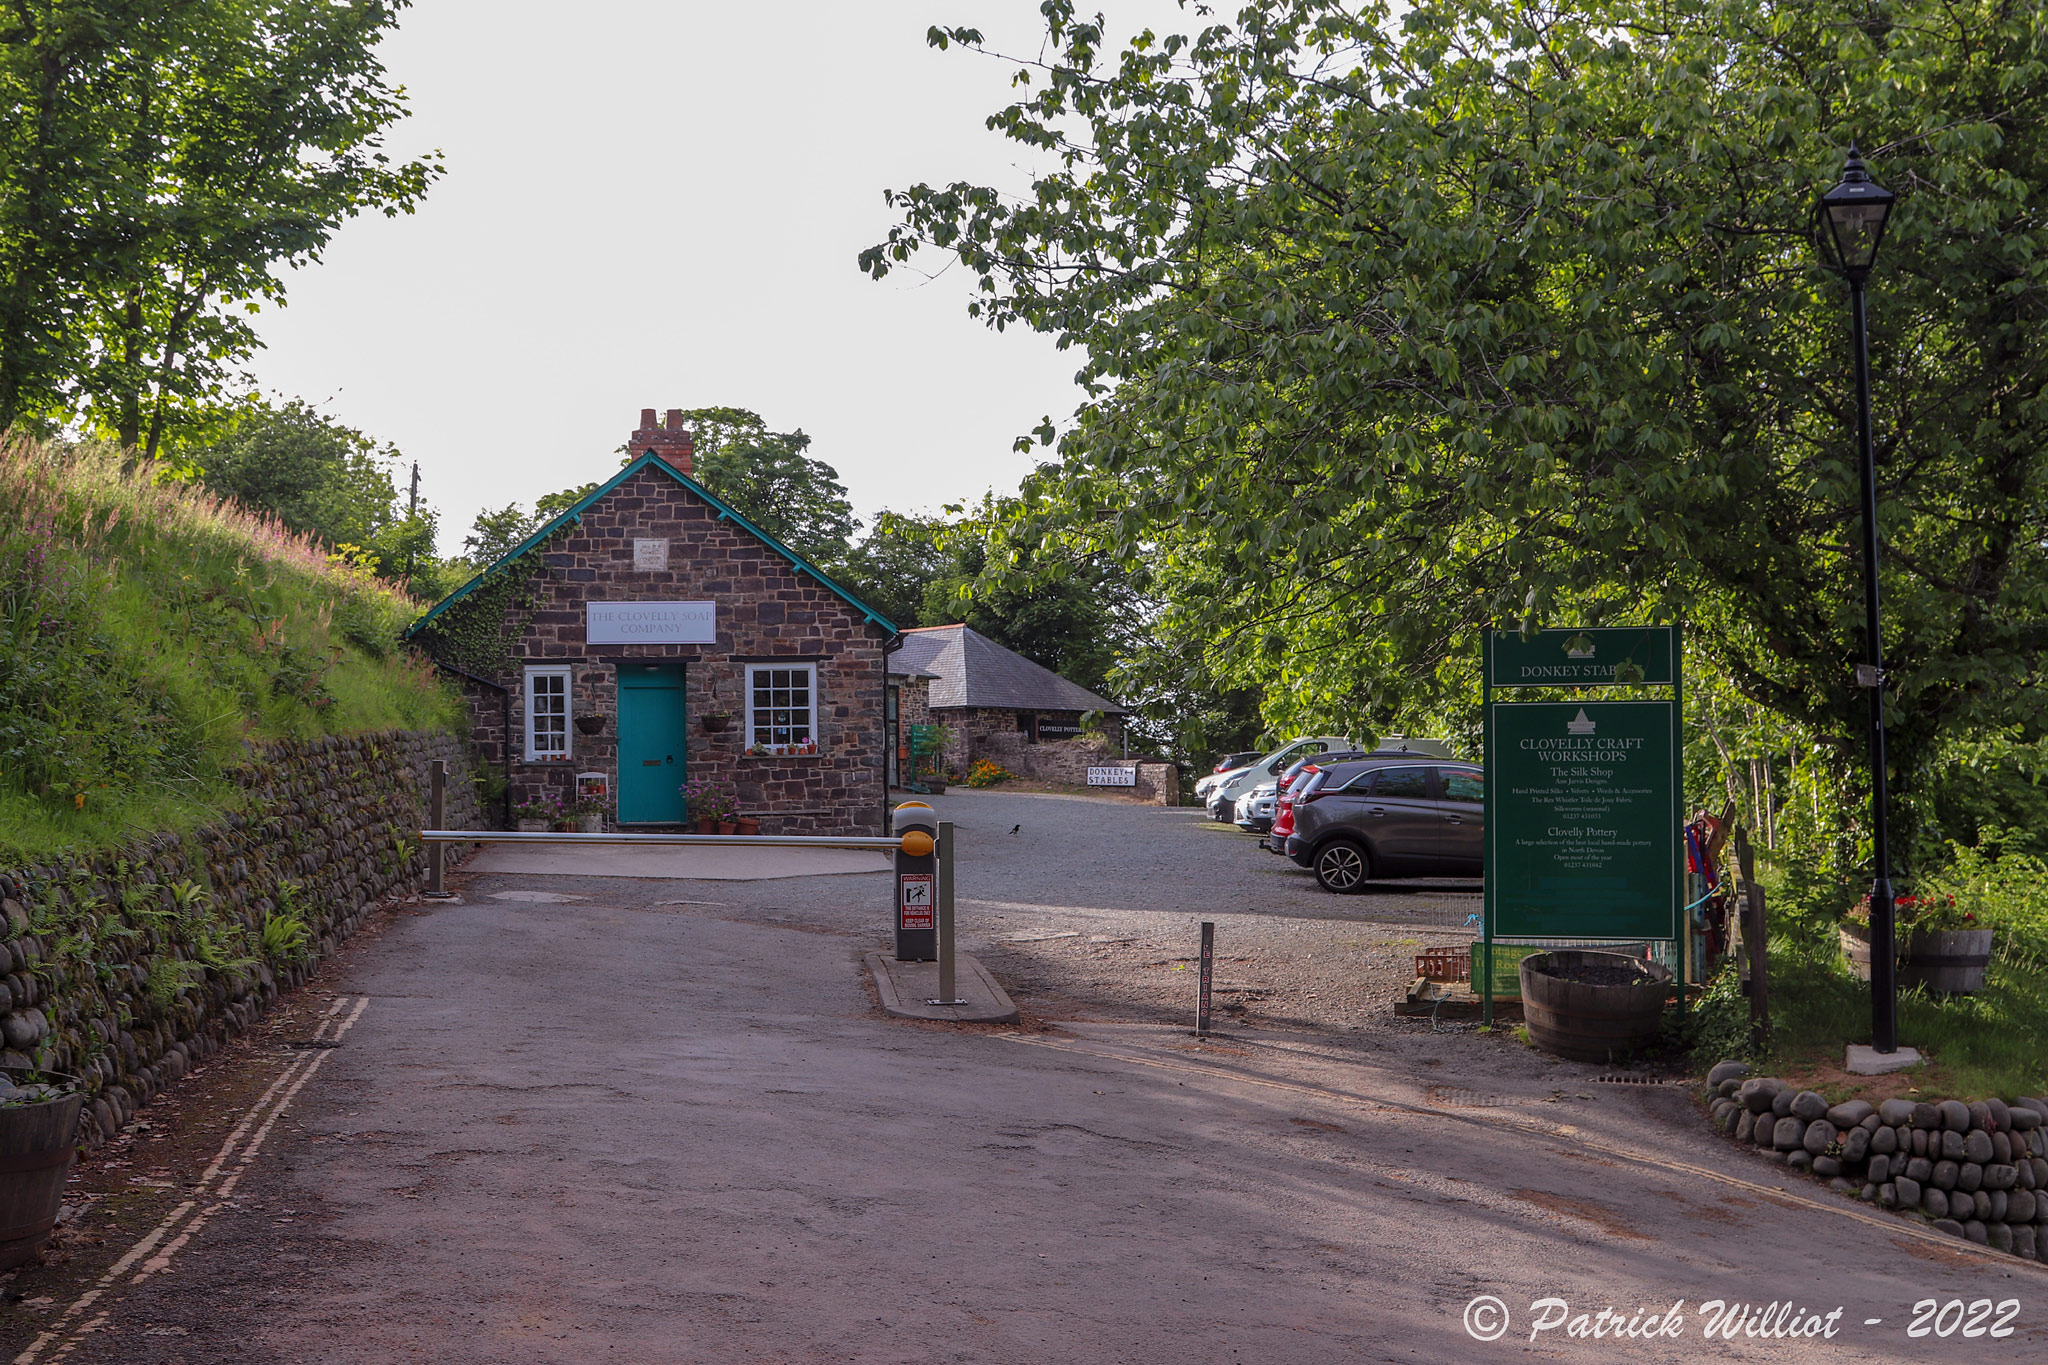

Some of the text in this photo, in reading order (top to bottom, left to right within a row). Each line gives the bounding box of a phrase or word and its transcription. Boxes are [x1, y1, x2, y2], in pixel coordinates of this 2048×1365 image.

[591, 611, 713, 621] THE CLOVELLY SOAP
[620, 624, 683, 633] COMPANY
[1521, 665, 1642, 677] DONKEY STAB
[1520, 738, 1644, 749] CLOVELLY CRAFT
[1538, 751, 1627, 762] WORKSHOPS
[1090, 768, 1125, 776] DONKEY
[1550, 767, 1614, 778] The Silk Shop
[1088, 776, 1129, 785] STABLES
[1547, 827, 1618, 838] Clovelly Pottery
